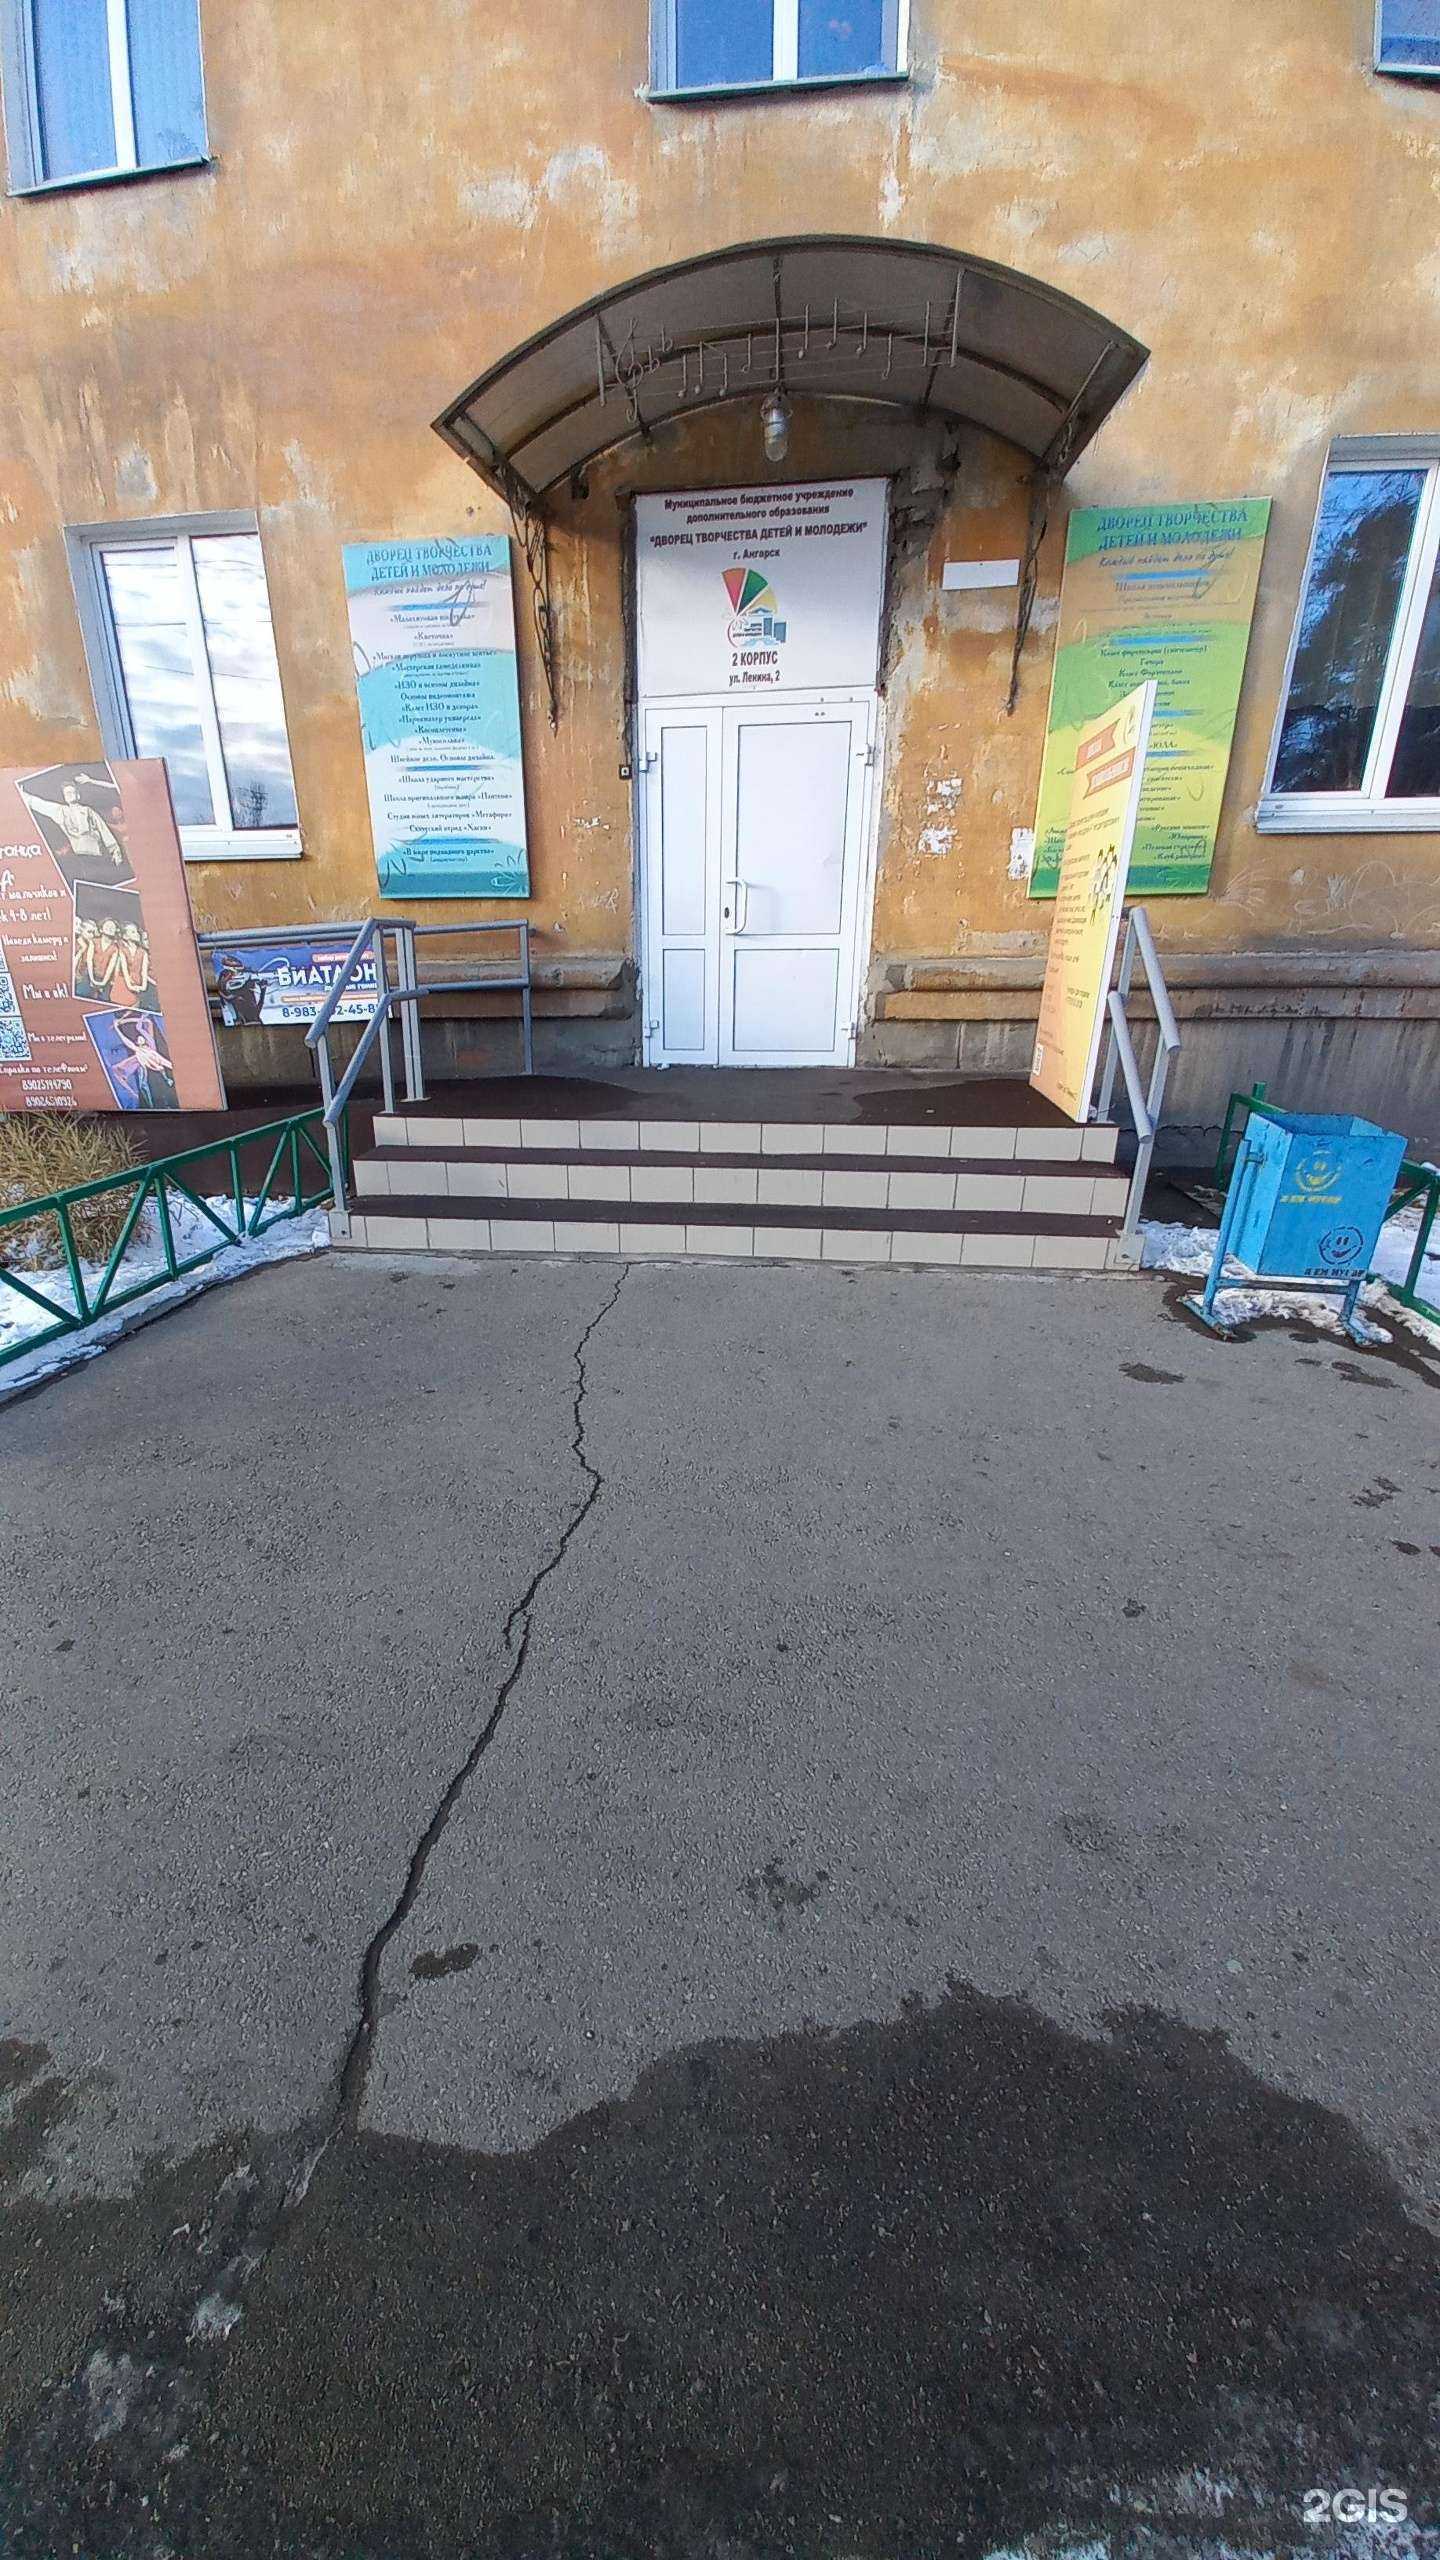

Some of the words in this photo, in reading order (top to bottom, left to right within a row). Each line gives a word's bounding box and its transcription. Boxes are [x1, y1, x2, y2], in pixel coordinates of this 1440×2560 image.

[664, 497, 737, 511] Муниципальное
[739, 493, 794, 506] бюджетное
[796, 488, 855, 503] учреждение
[686, 510, 766, 525] дополнительного
[768, 505, 830, 519] образования
[1097, 513, 1154, 531] ДВОРЕЦ
[1157, 510, 1248, 526] ТВОРЧЕСТВА
[695, 529, 758, 544] ТВОРЧЕСТВА
[760, 525, 793, 541] ДЕТЕЙ
[795, 526, 802, 537] И
[1098, 533, 1143, 551] ДЕТЕЙ
[1161, 528, 1242, 546] МОЛОДЕЖИ
[366, 548, 412, 565] ДВОРЕЦ
[415, 544, 491, 560] ТВОРЧЕСТВА
[371, 564, 408, 581] ДЕТЕЙ
[421, 560, 490, 576] МОЛОДЕЖИ
[732, 652, 739, 667] 2
[739, 650, 779, 667] КОРПУС
[729, 674, 741, 687] ул.
[742, 671, 774, 684] Ленина,
[774, 670, 781, 682] 2
